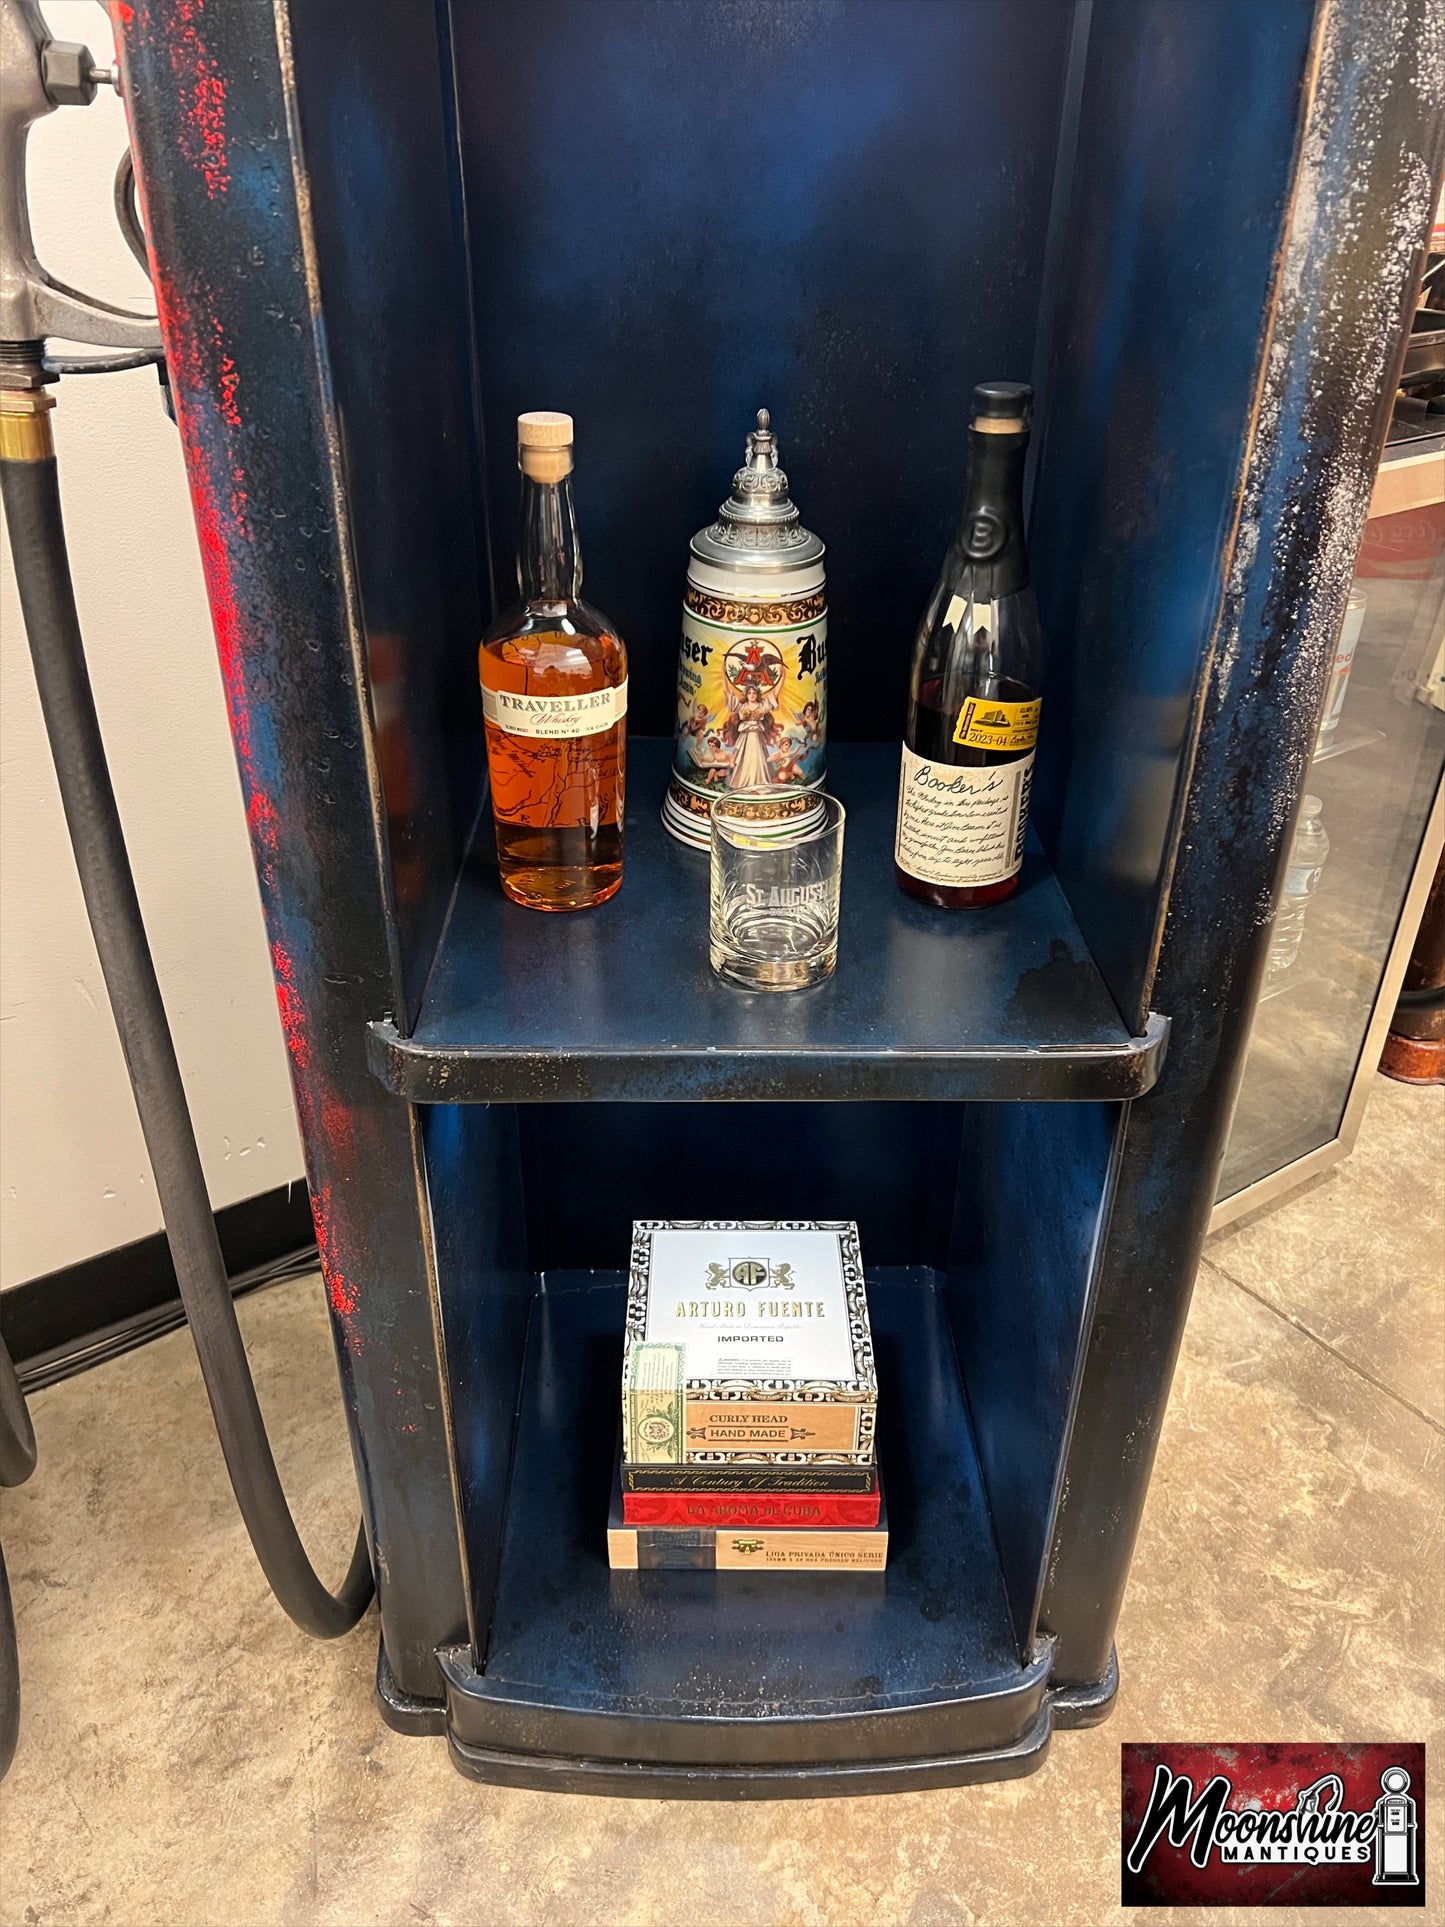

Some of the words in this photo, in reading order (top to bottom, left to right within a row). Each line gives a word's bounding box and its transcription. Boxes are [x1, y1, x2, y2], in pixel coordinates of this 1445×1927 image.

[499, 692, 611, 713] TRAVELLER
[530, 713, 582, 727] Whiskey
[968, 732, 1008, 746] 2023-04
[914, 765, 1003, 795] Booker's
[675, 1301, 746, 1317] ARTURO
[758, 1302, 825, 1318] FUENTE
[709, 1415, 749, 1423] CURLY
[752, 1415, 788, 1423] HEAD
[710, 1429, 746, 1437] HAND
[750, 1429, 786, 1438] MADE
[671, 1476, 688, 1486] A
[691, 1475, 744, 1487] Century
[748, 1476, 766, 1488] Of
[767, 1477, 829, 1487] Tradition
[687, 1505, 705, 1515] LA
[710, 1505, 759, 1516] AROMA
[783, 1505, 821, 1516] CUBA
